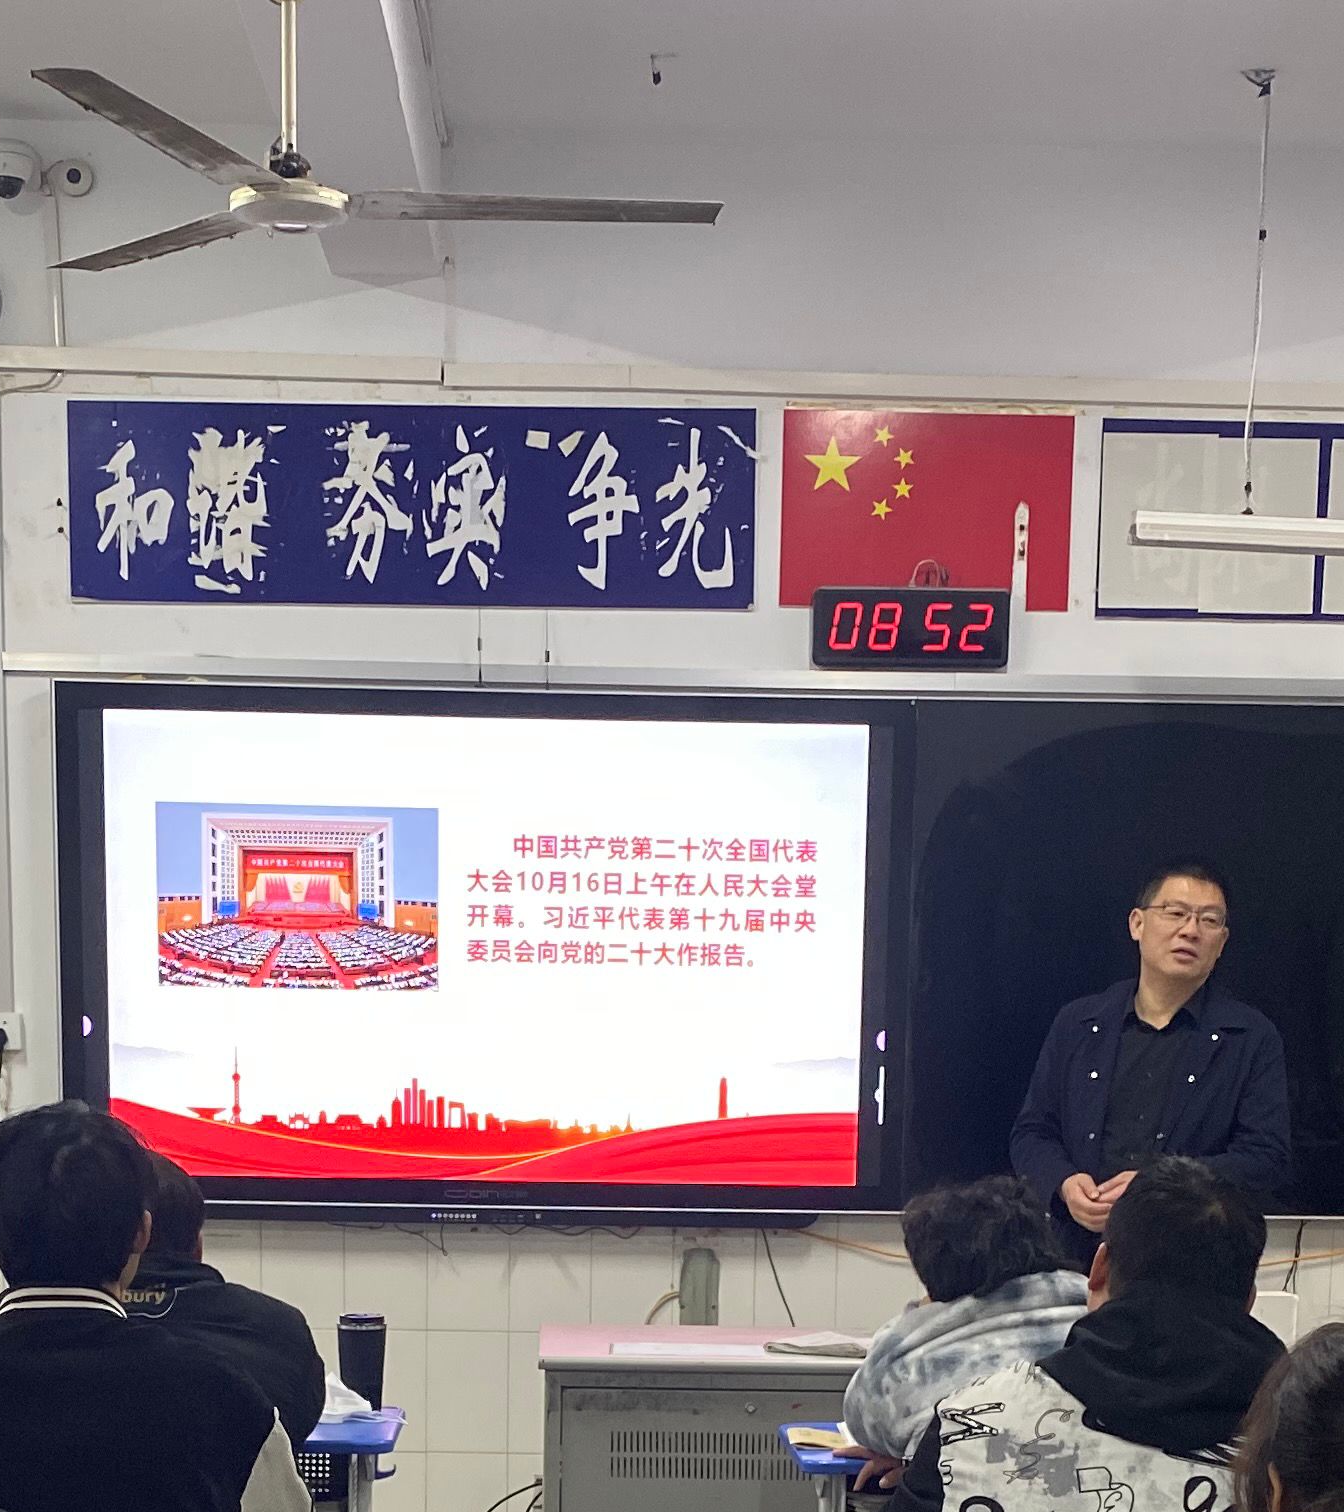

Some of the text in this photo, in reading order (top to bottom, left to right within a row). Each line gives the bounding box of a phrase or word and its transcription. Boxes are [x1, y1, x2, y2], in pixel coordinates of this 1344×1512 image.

[566, 427, 734, 590] 争先
[828, 601, 995, 652] 08 52
[513, 833, 818, 863] 中国共产党第二十次全国代表
[466, 868, 818, 899] 大会10月16日上午在人民大会堂
[466, 939, 755, 968] 委员会向党的二十大作报告。
